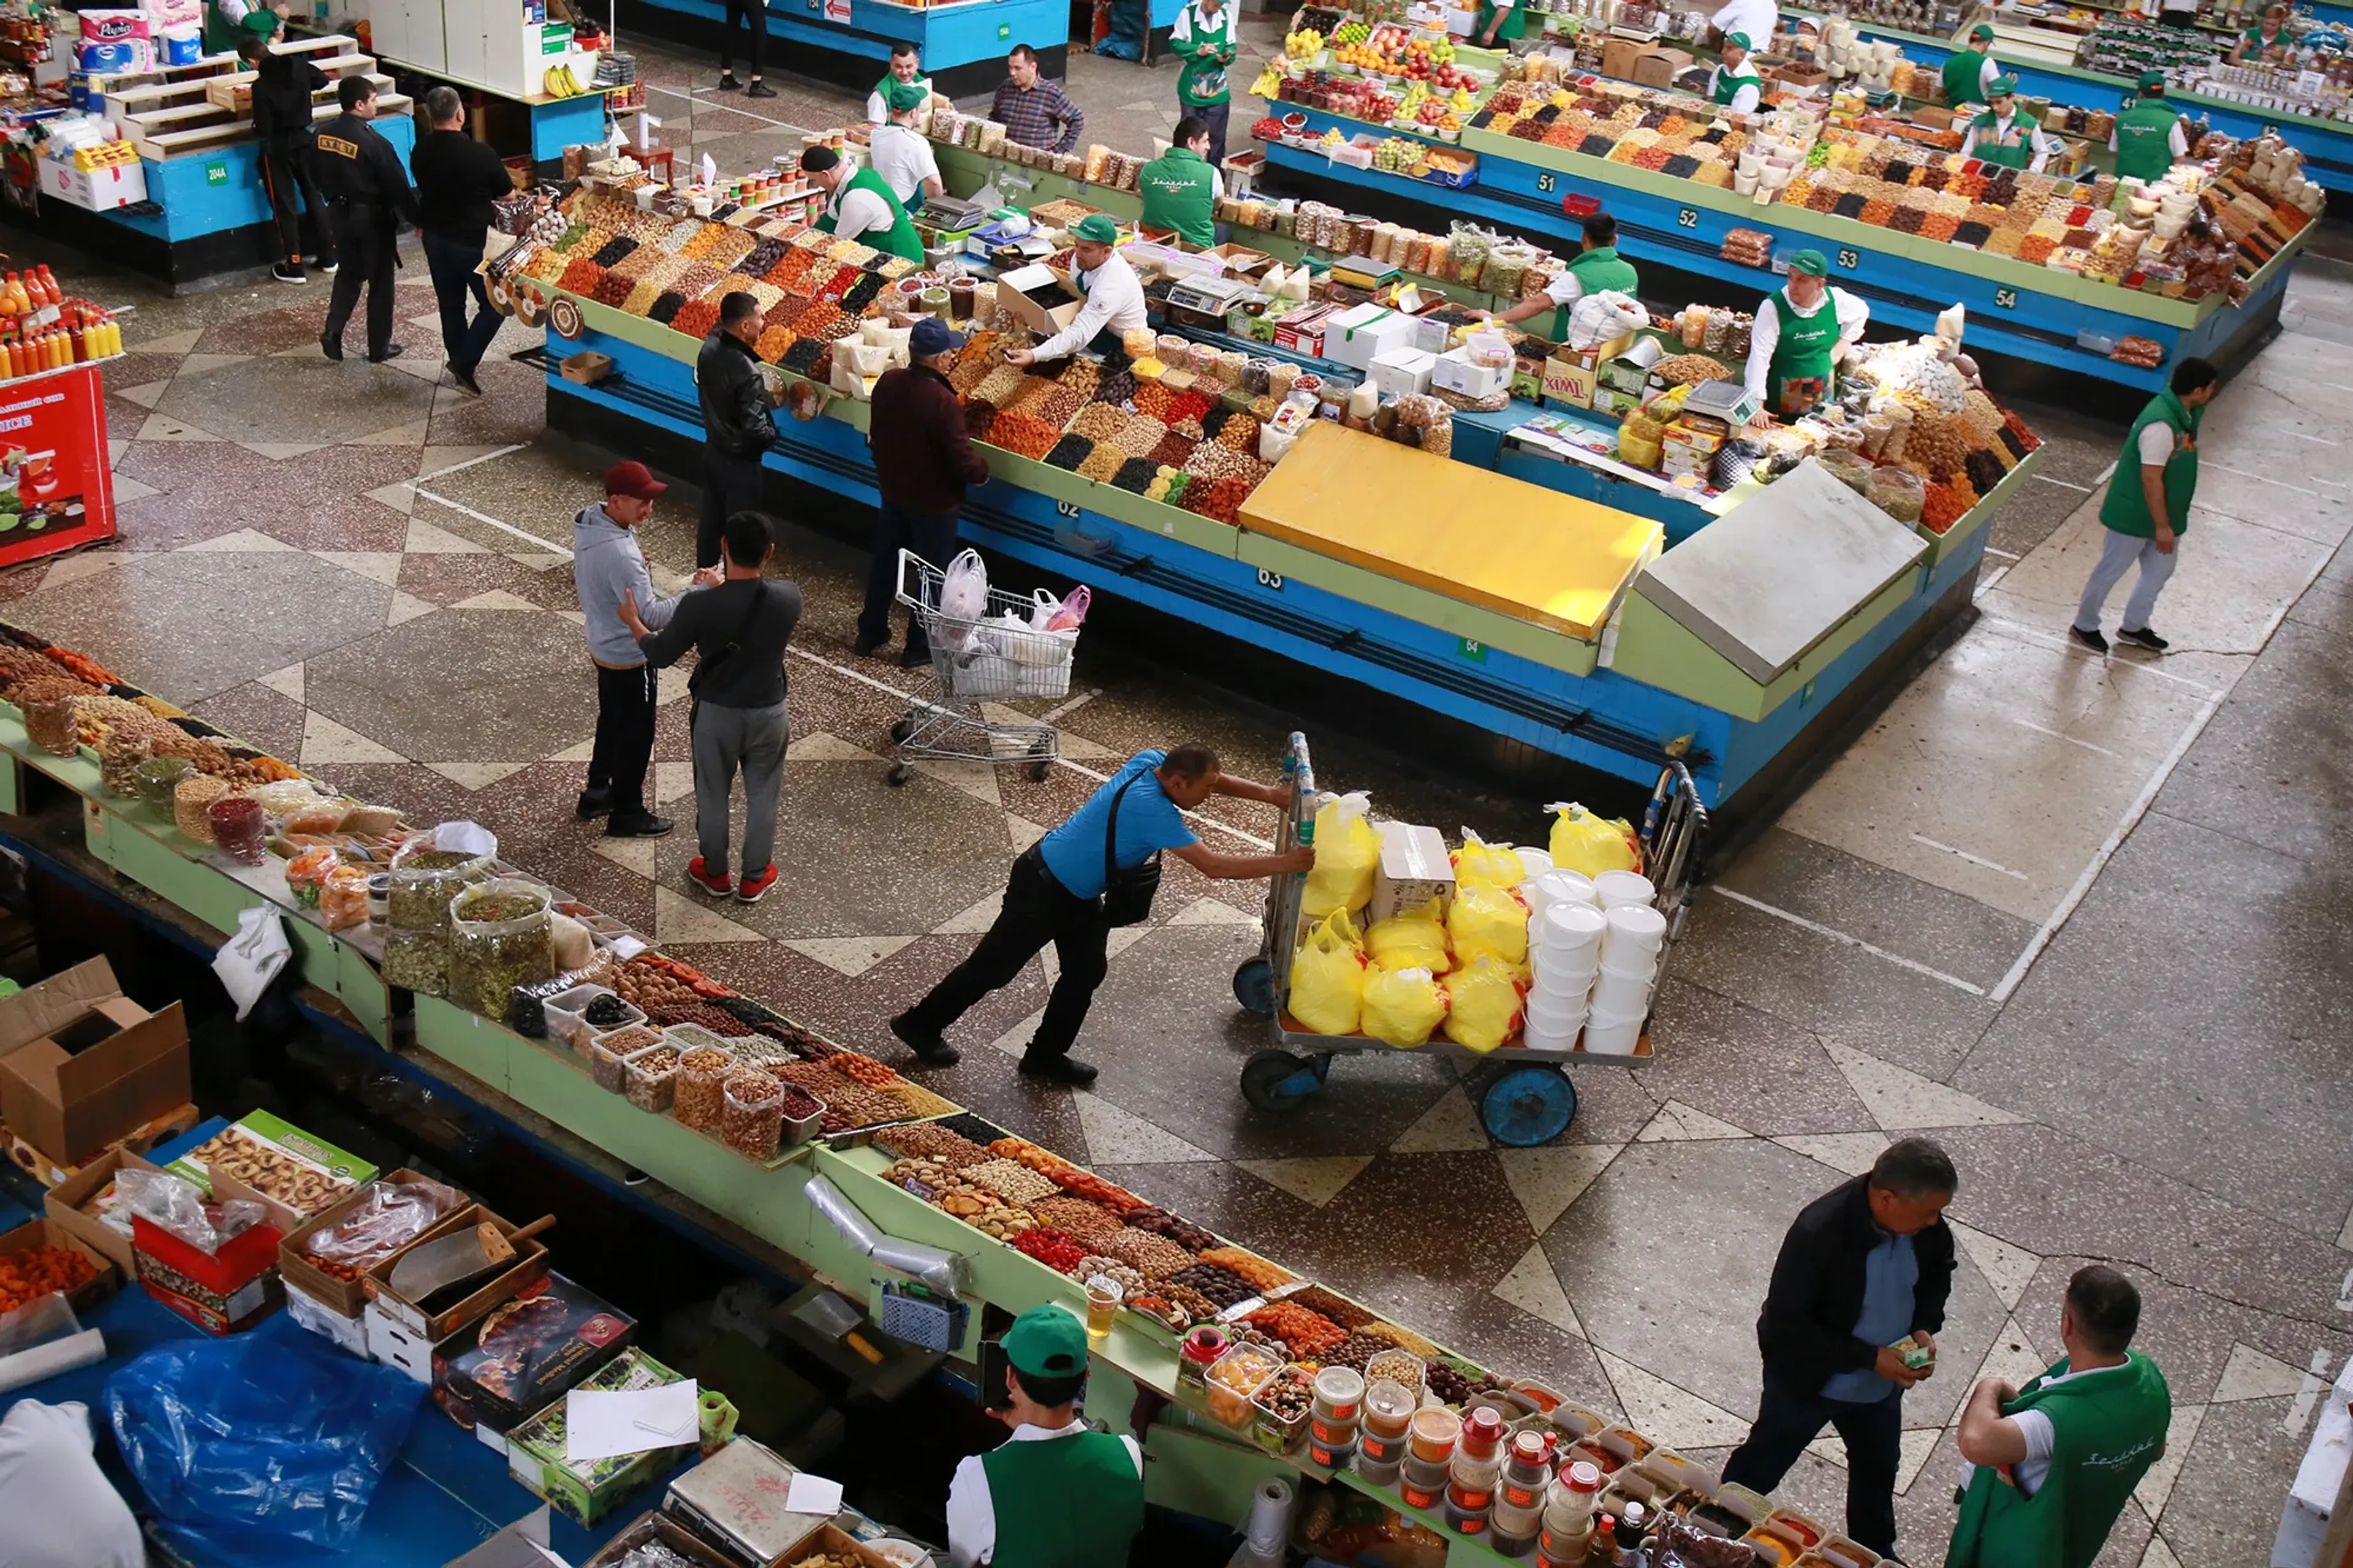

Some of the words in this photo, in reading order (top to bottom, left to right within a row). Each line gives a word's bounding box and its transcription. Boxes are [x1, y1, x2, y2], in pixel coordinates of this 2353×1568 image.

[2121, 97, 2137, 109] 41
[208, 167, 227, 180] 204A
[1539, 175, 1554, 192] 51
[1680, 209, 1697, 227] 52
[1839, 251, 1857, 268] 53
[1996, 290, 2015, 308] 54
[1259, 568, 1282, 588] 63
[1466, 639, 1478, 654] 64
